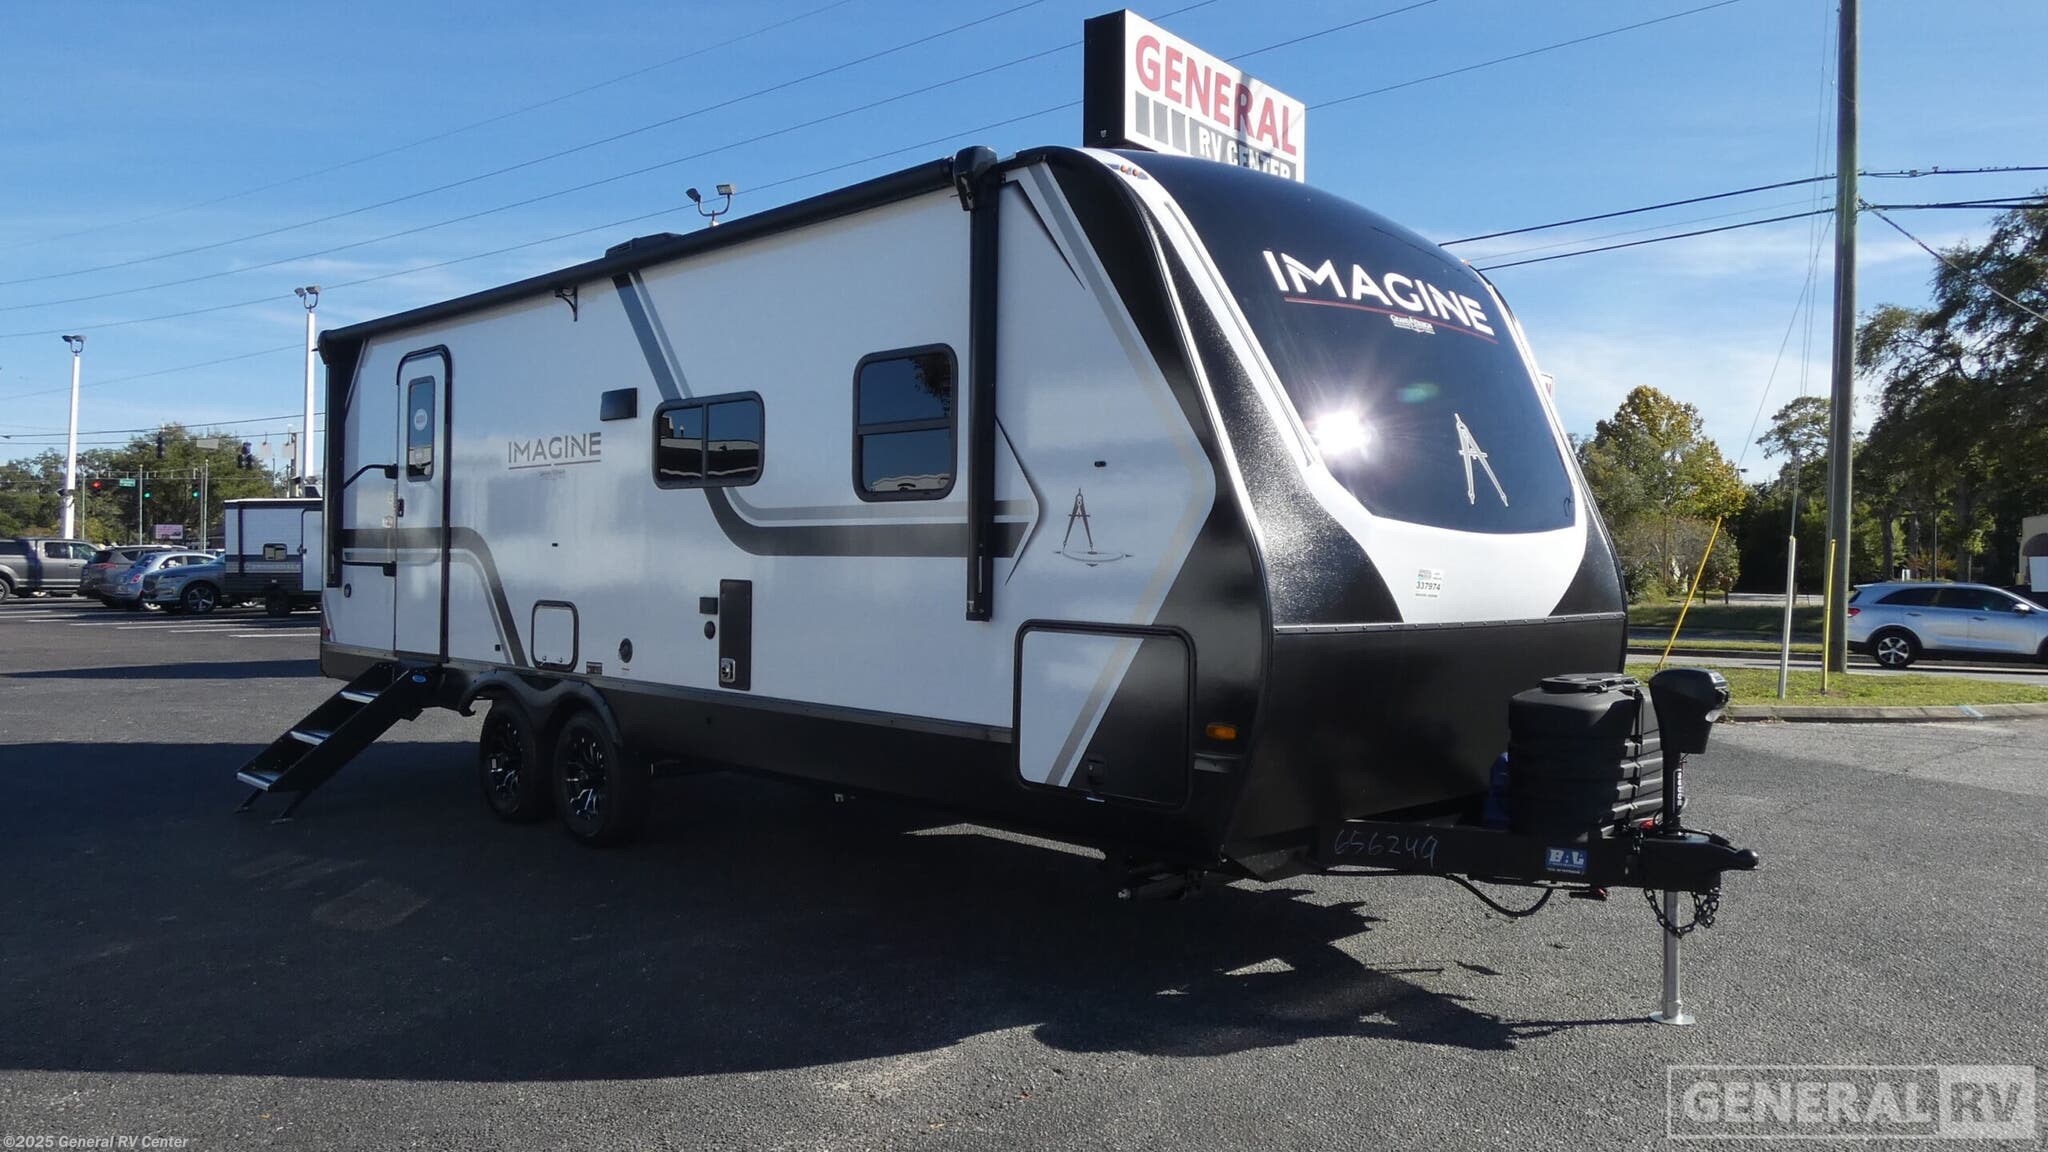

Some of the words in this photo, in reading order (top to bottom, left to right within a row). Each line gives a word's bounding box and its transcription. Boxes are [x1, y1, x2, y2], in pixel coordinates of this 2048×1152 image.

[1135, 35, 1297, 156] GENERAL
[1199, 126, 1222, 162] RV
[1227, 140, 1291, 179] CENTER
[1262, 250, 1495, 336] IMAGINE
[508, 431, 602, 464] IMAGINE
[1415, 580, 1441, 591] 337974
[1334, 829, 1439, 868] 656249
